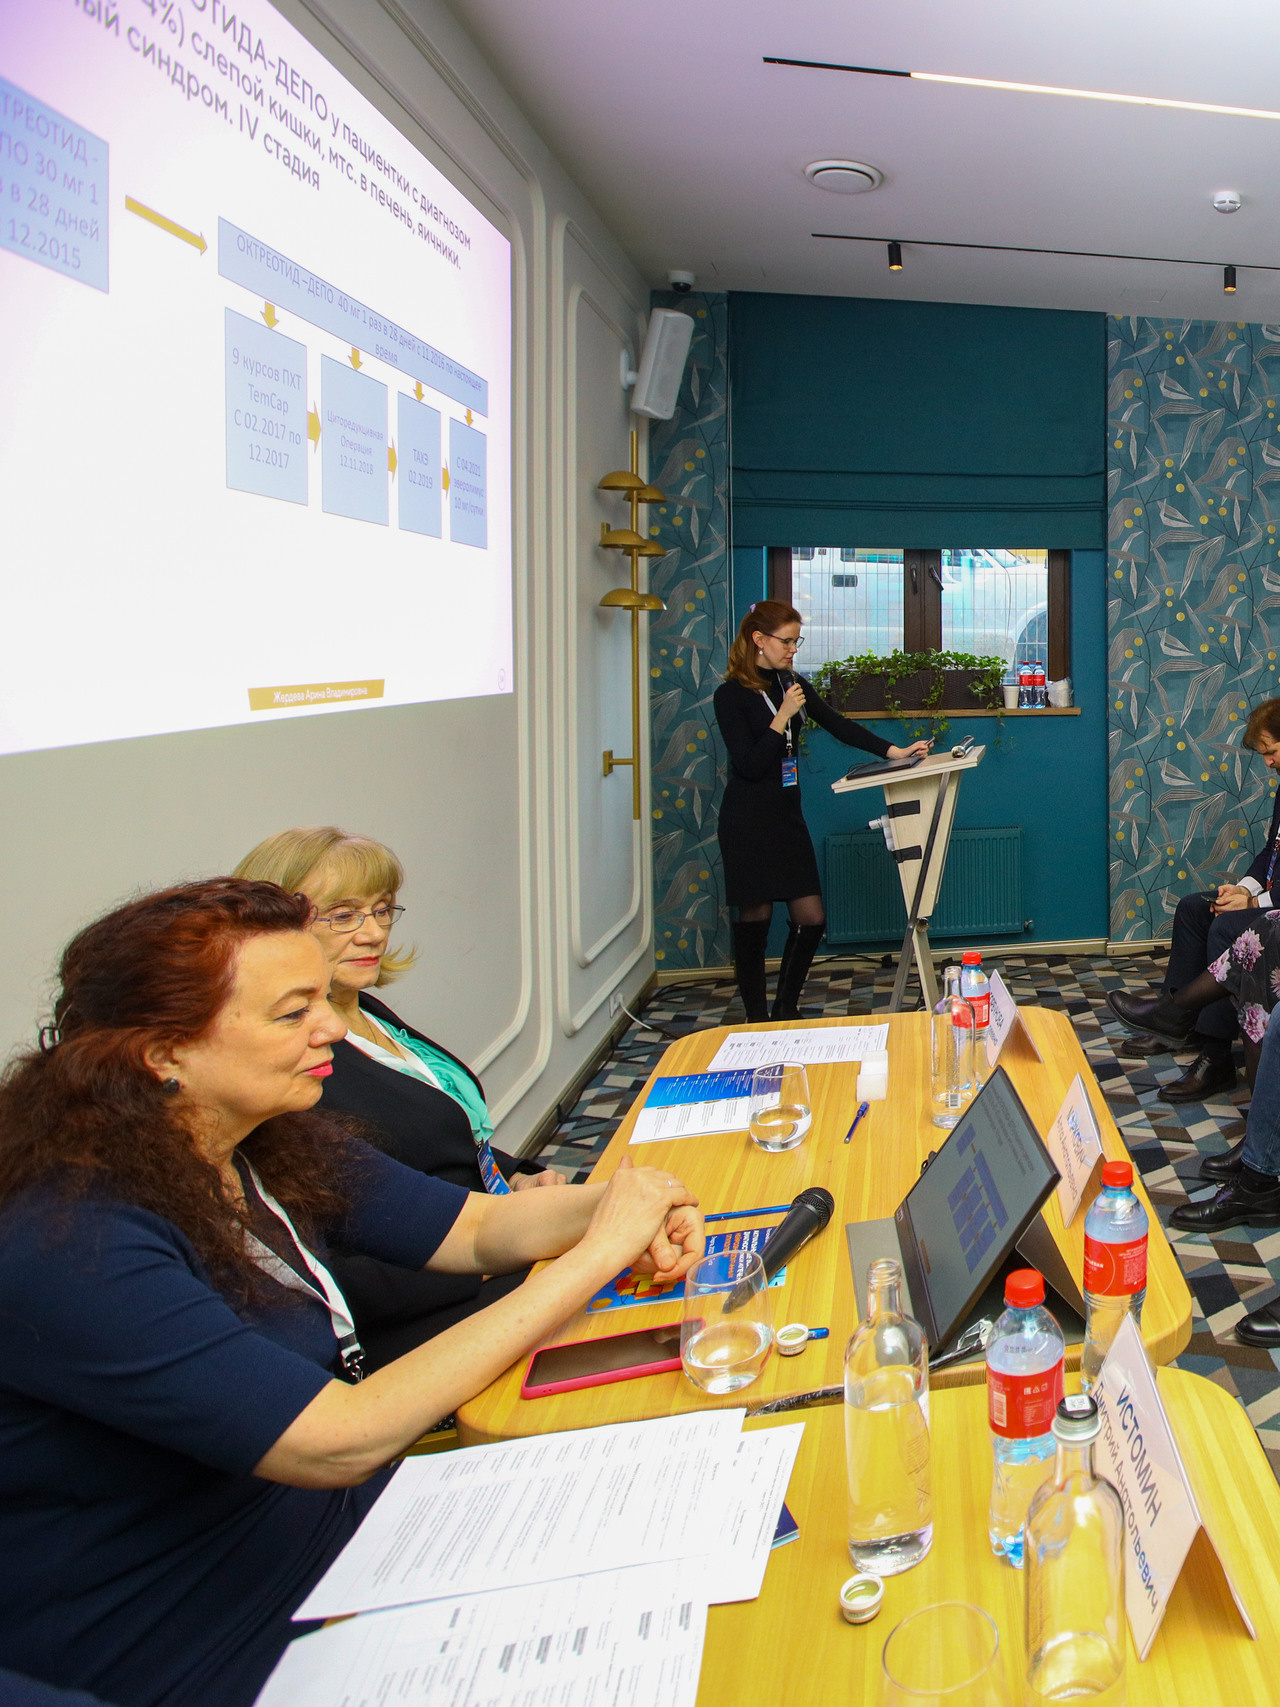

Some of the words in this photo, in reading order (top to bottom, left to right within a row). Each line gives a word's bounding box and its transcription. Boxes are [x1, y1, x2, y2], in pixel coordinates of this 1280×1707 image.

[73, 0, 120, 37] ый
[127, 26, 234, 125] синдром.
[239, 104, 260, 140] IV
[263, 132, 320, 191] стадия
[191, 31, 264, 107] слепой
[269, 95, 326, 161] кишки,
[329, 147, 358, 185] мтс.
[360, 173, 368, 193] в
[370, 181, 417, 235] печень,
[417, 222, 462, 270] яичники.
[35, 151, 58, 183] 30
[63, 172, 85, 197] мг
[90, 183, 98, 206] 1
[331, 112, 340, 139] у
[343, 123, 410, 197] пациентки
[411, 187, 419, 203] с
[420, 194, 471, 251] диагнозом
[11, 182, 21, 204] в
[28, 186, 50, 218] 28
[55, 207, 100, 242] дней
[9, 217, 82, 271] 12.2015
[236, 234, 300, 288] ОКТРЕОТИД
[337, 295, 349, 313] 40
[350, 304, 361, 319] мг
[362, 310, 368, 325] 1
[369, 316, 382, 332] раз
[383, 325, 388, 336] в
[389, 325, 398, 341] 28
[399, 335, 416, 353] дней
[232, 347, 240, 365] 9
[242, 355, 280, 382] курсов
[282, 368, 302, 391] ПХТ
[375, 344, 398, 364] время
[248, 382, 289, 416] TemCap
[244, 412, 286, 441] 02.2017
[289, 430, 301, 446] по
[340, 435, 372, 456] Операция
[249, 443, 290, 470] 12.2017
[340, 454, 374, 476] 12.11.2018
[412, 448, 429, 466] ТАХЭ
[408, 469, 433, 490] 02.2019
[273, 690, 305, 705] Жердева
[305, 689, 326, 703] Арина
[326, 685, 368, 700] Владимировна
[1116, 1384, 1163, 1528] ИСТОМИН
[1093, 1381, 1119, 1465] Дмитрий
[1113, 1459, 1159, 1615] Анатольевич
